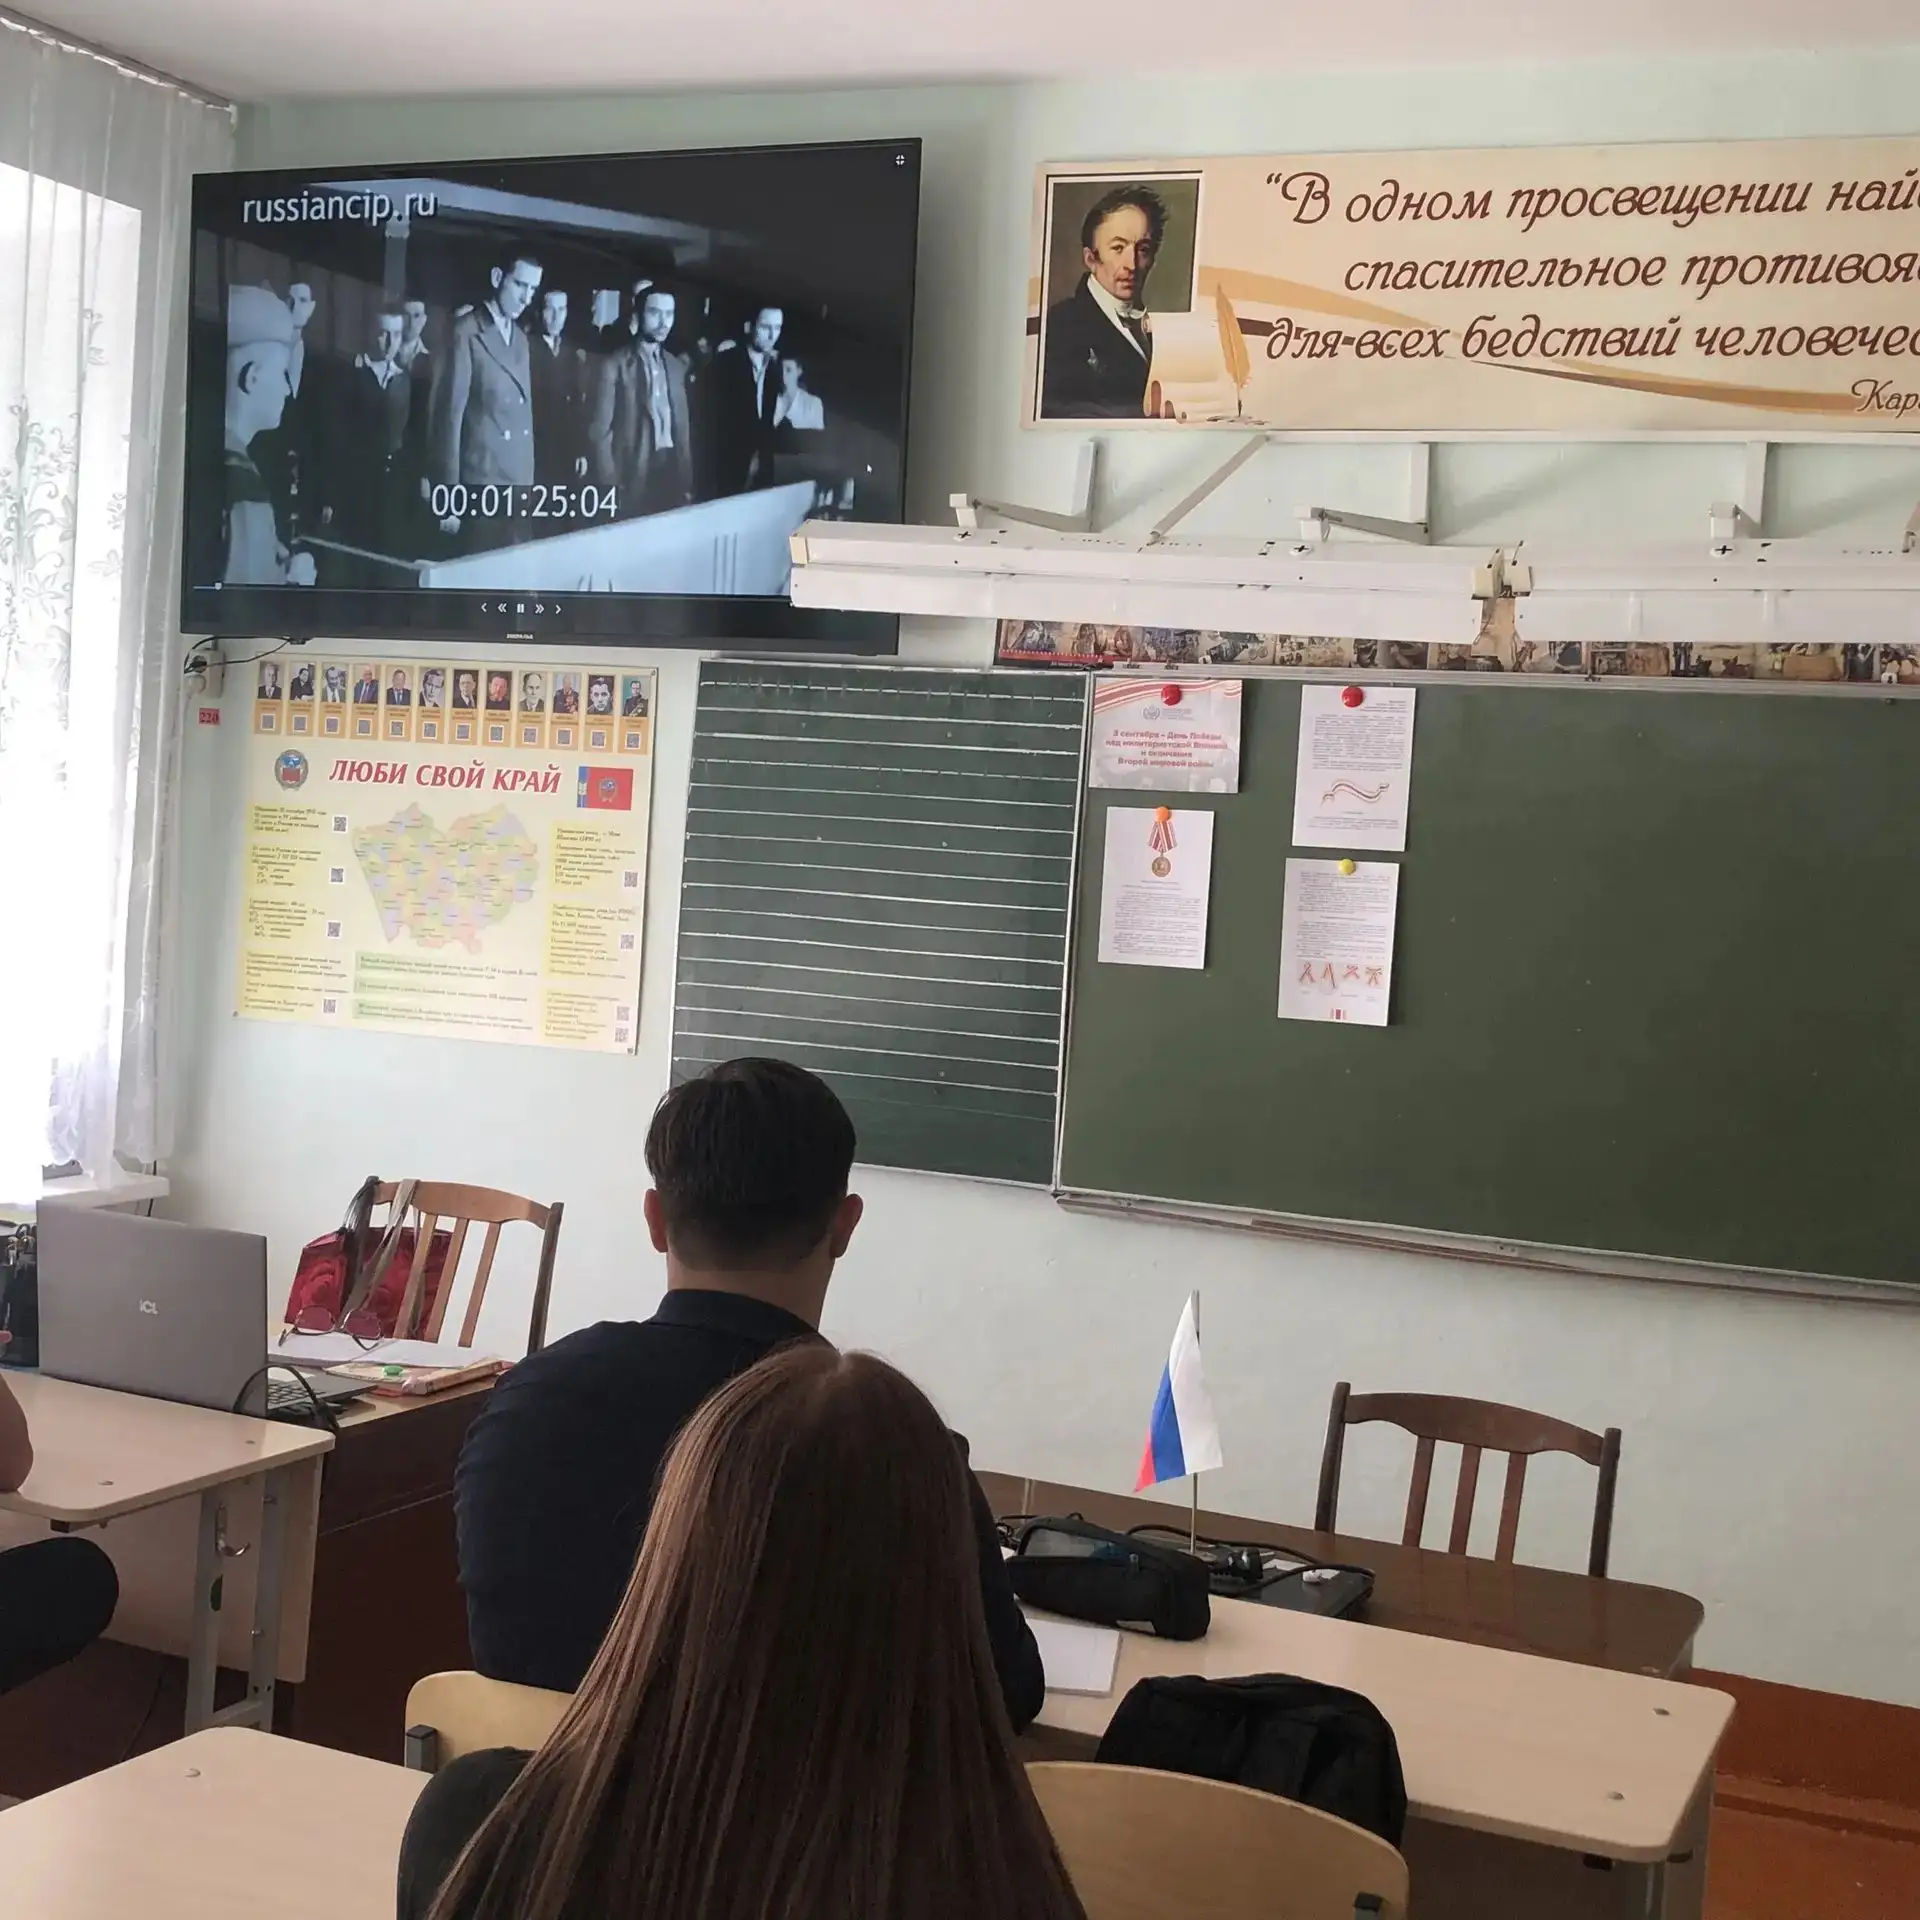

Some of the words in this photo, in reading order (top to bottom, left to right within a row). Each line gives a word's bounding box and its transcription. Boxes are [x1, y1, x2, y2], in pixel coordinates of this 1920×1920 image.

[242, 190, 436, 228] russiancip.ru
[1345, 178, 1494, 223] одном
[1504, 181, 1813, 233] просвещении
[1825, 166, 1920, 213] най
[1344, 252, 1667, 291] спасительное
[1680, 251, 1920, 301] противоя
[1266, 316, 1343, 360] для
[1354, 328, 1451, 359] всех
[1461, 314, 1682, 358] бедствий
[431, 484, 618, 518] 00:01:25:04
[1120, 730, 1159, 740] сентября
[1166, 731, 1188, 740] День
[329, 759, 408, 785] ЛЮБИ
[415, 759, 485, 790] СВОЙ
[492, 763, 562, 794] КРАЙ
[1117, 757, 1149, 767] Второй
